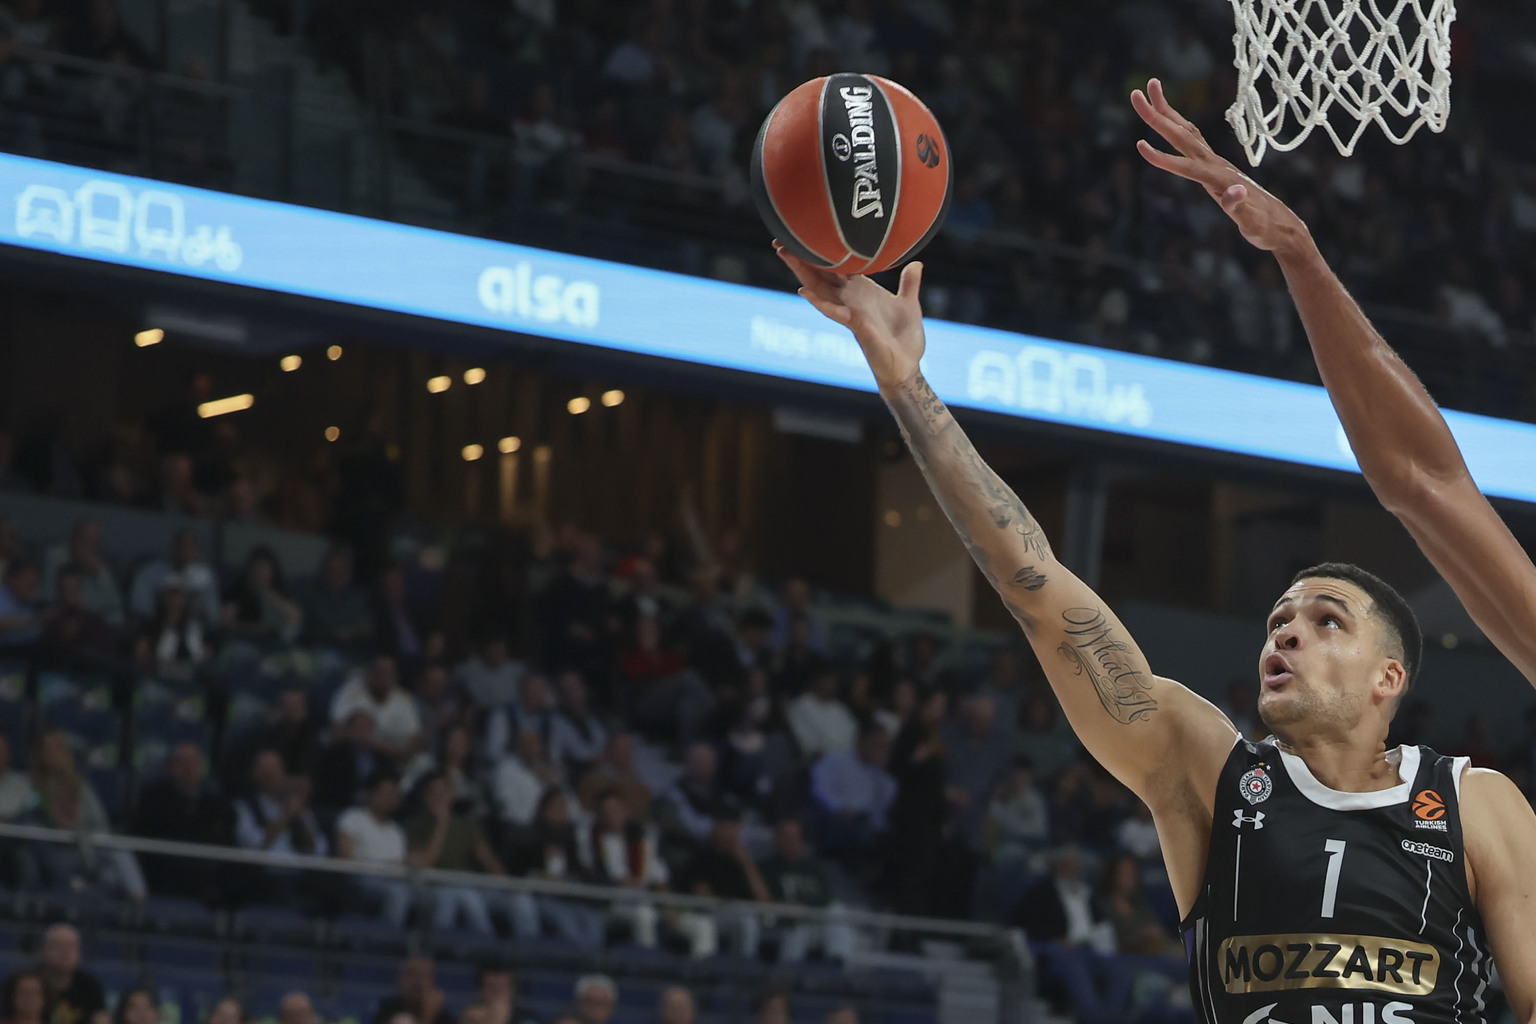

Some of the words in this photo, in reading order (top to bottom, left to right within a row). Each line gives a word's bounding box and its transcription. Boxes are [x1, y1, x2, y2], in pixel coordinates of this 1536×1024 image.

[839, 86, 884, 219] SPALDING
[478, 261, 600, 329] alsa
[1320, 839, 1347, 918] 1
[1402, 839, 1454, 862] oneteam
[1225, 943, 1433, 985] MOZZART
